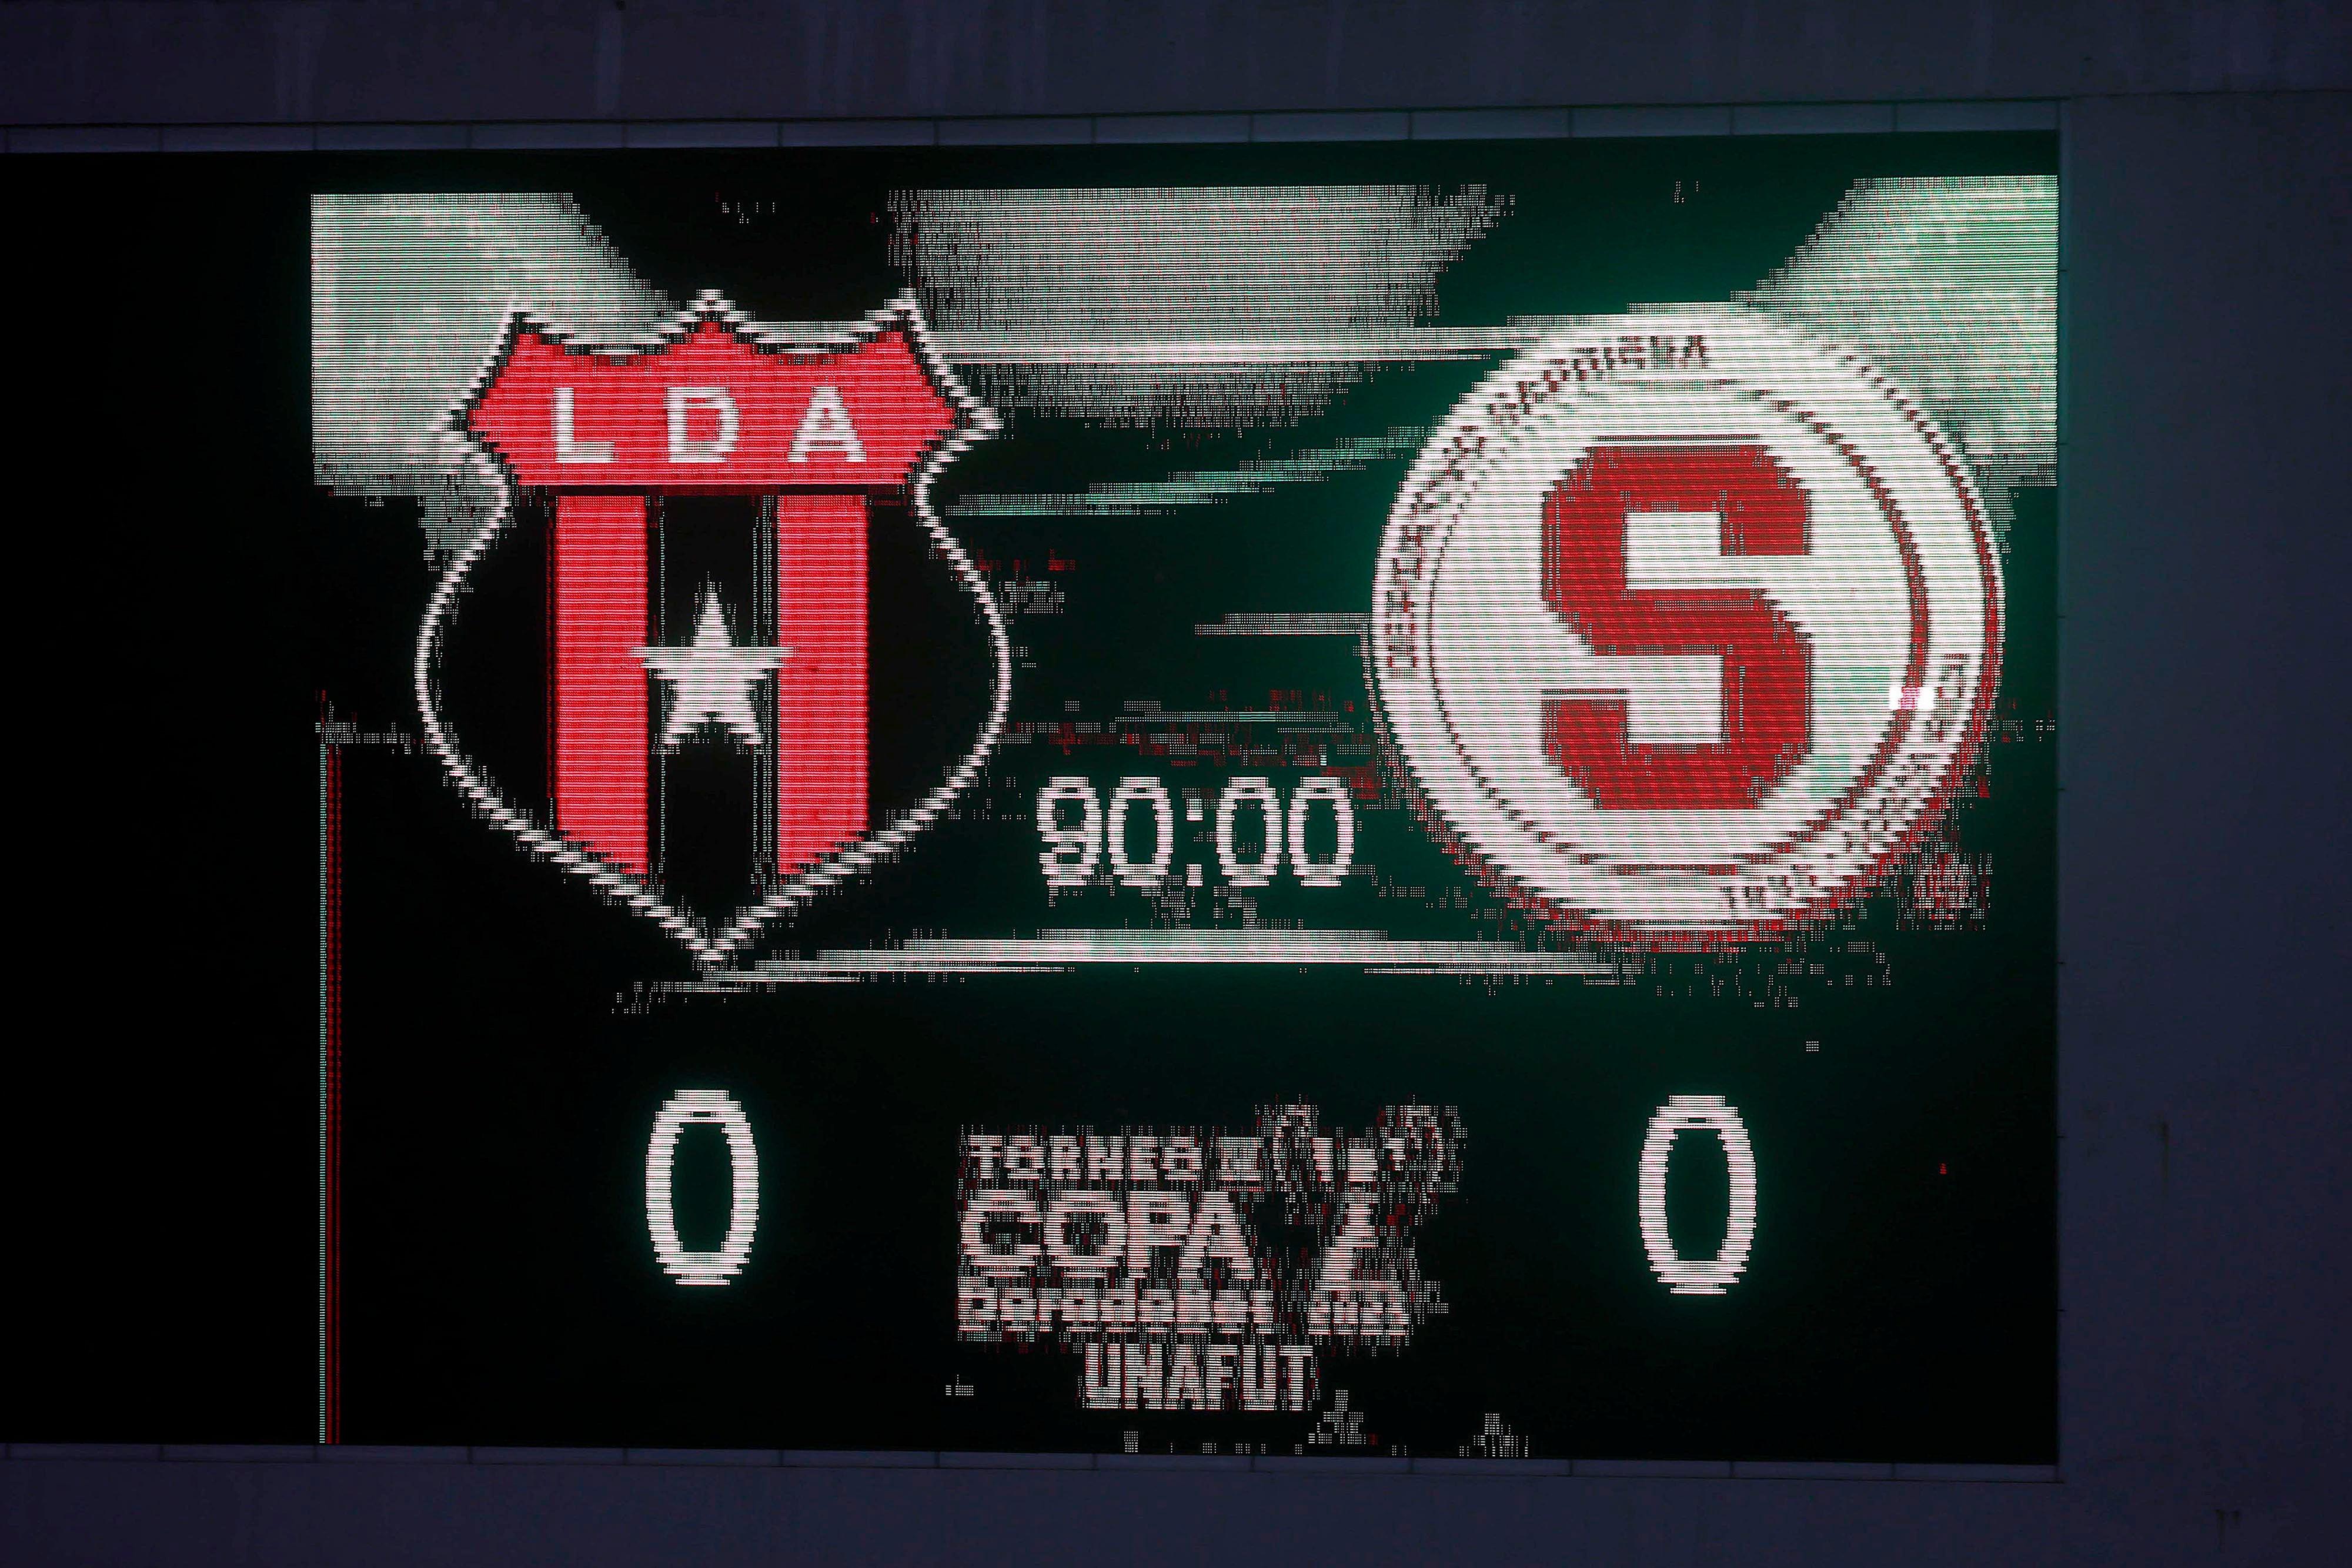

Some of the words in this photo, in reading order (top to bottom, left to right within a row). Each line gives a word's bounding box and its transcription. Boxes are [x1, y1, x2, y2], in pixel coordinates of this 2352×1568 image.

[553, 386, 867, 463] LDA
[1542, 434, 1812, 810] S
[1037, 776, 1354, 887] 90:00
[646, 1089, 759, 1285] 0
[968, 1135, 1202, 1181] TORNEO
[1638, 1095, 1757, 1295] 0
[961, 1190, 1255, 1279] COPA
[1084, 1343, 1314, 1411] UNAFUT
